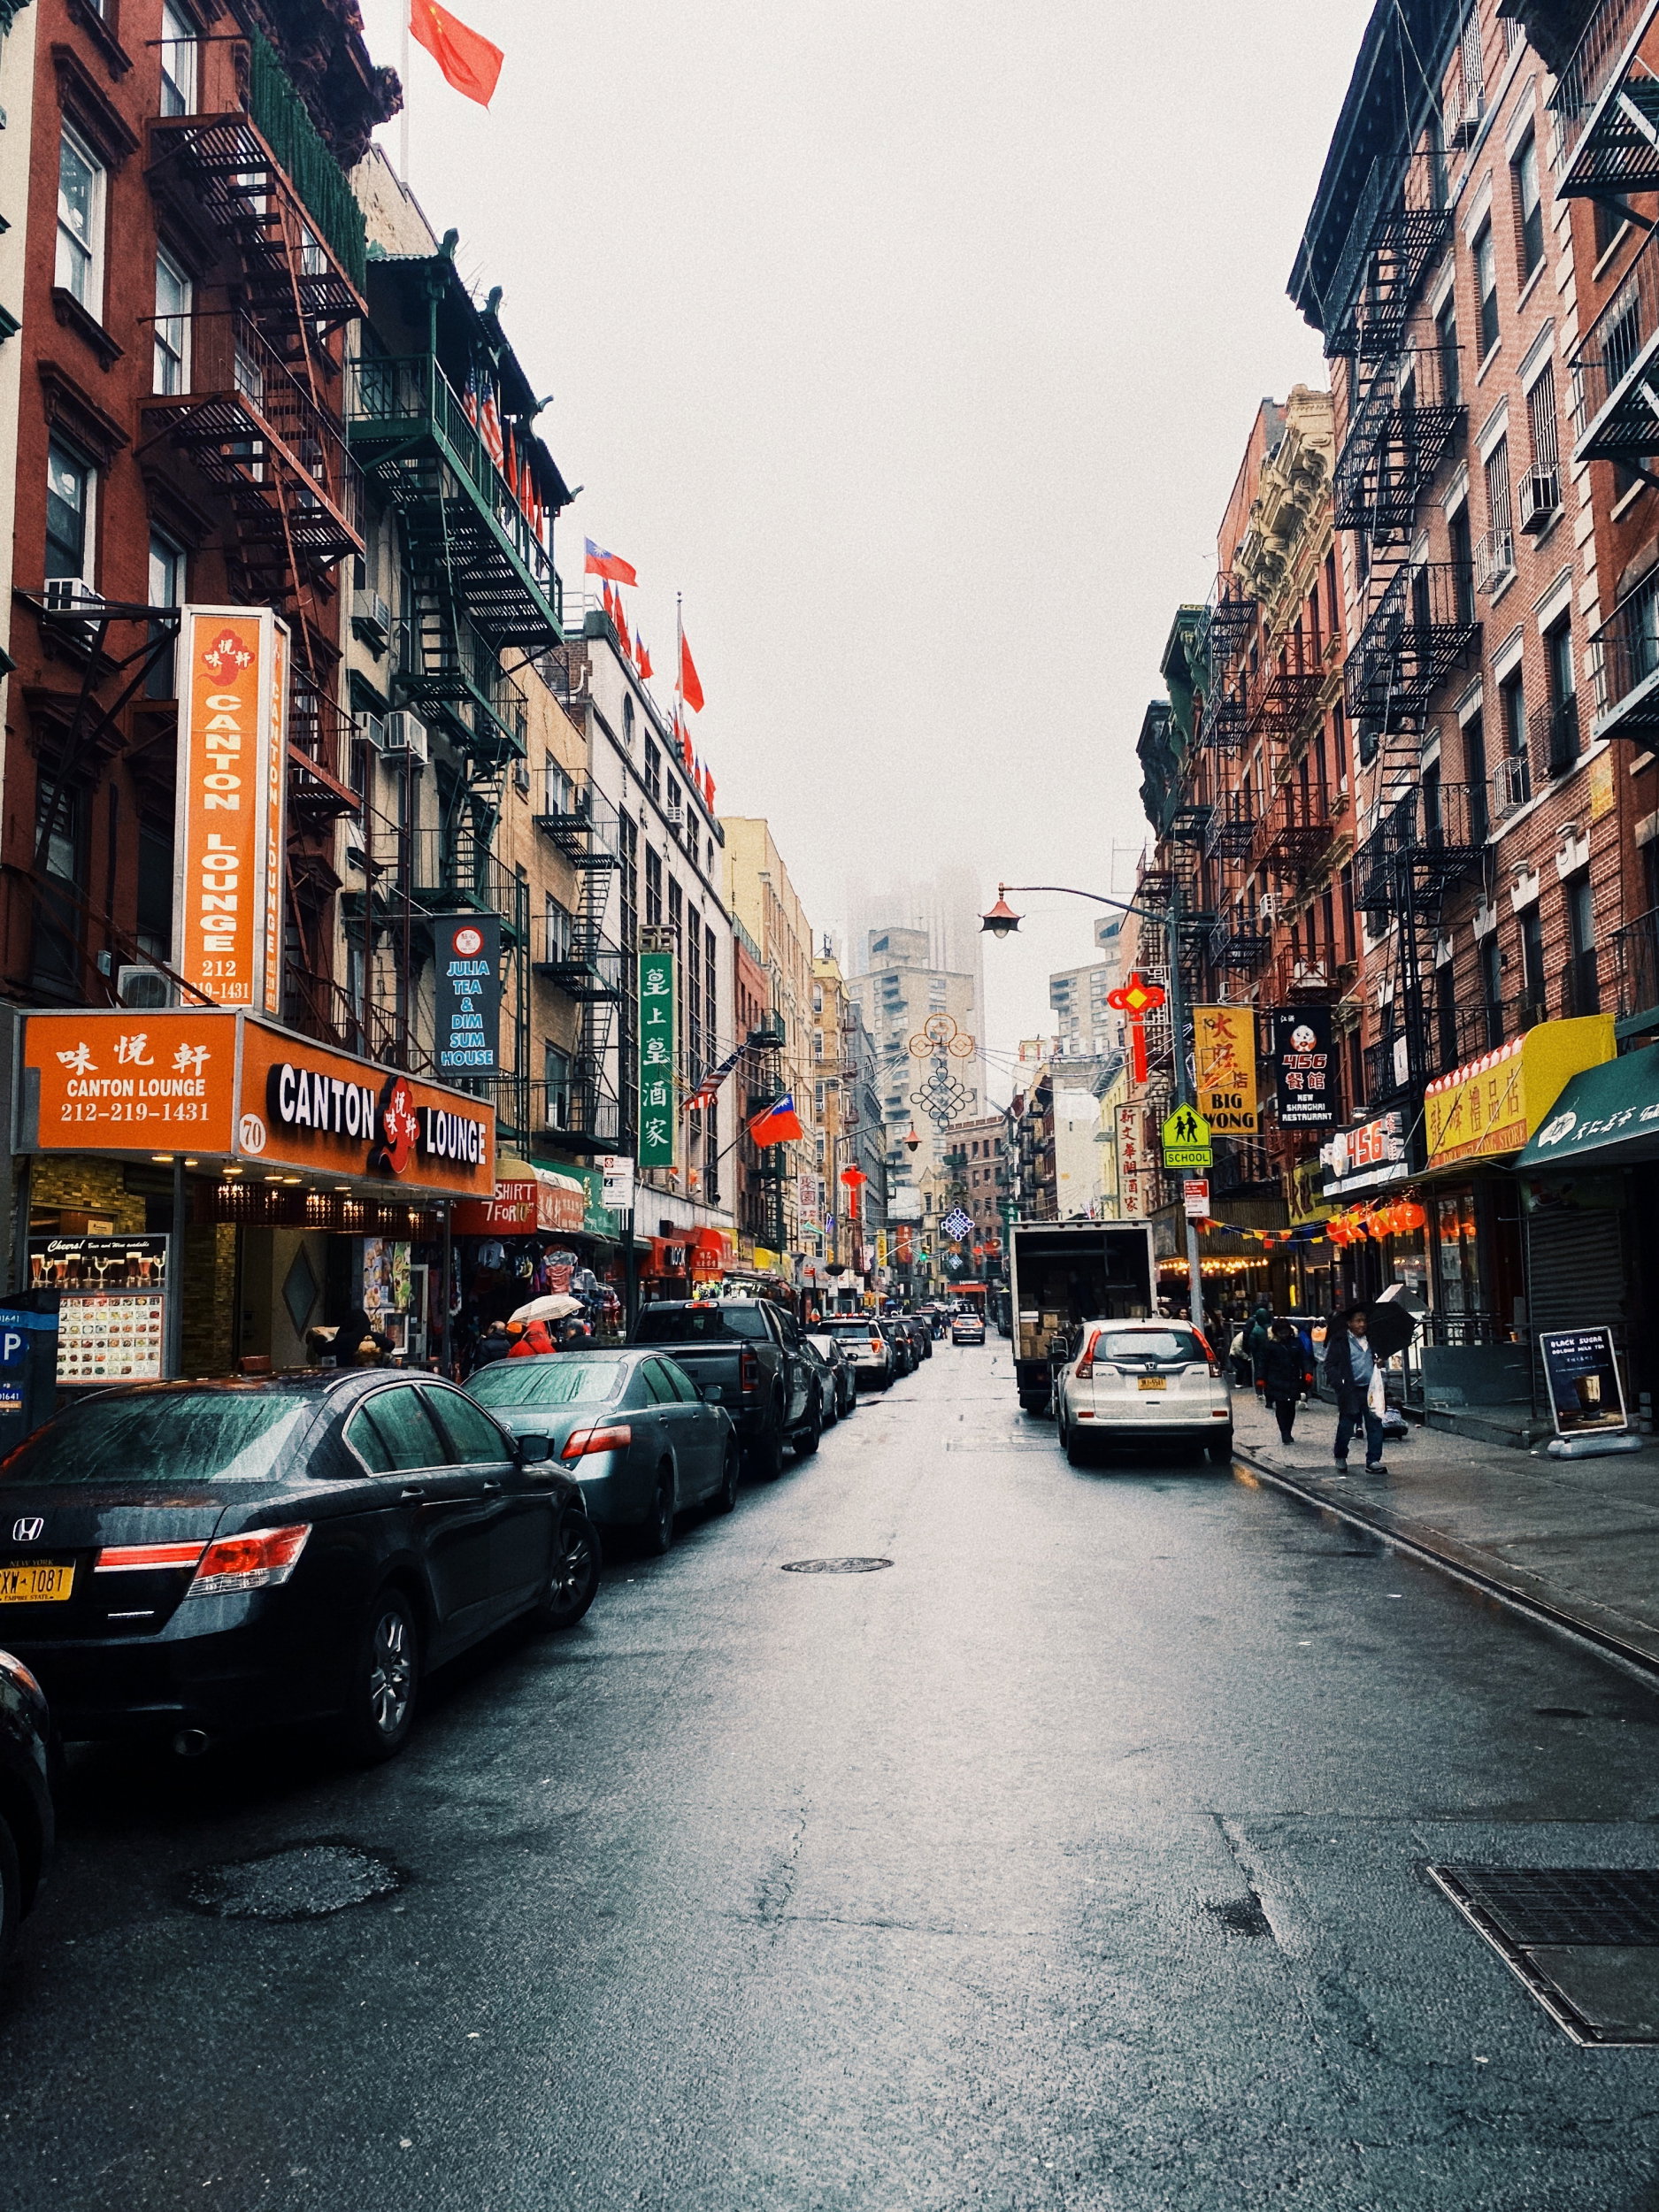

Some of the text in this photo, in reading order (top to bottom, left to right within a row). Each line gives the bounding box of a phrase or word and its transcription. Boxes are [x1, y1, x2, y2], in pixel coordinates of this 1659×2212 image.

[199, 694, 242, 952] CANTON LOUNGE
[266, 828, 277, 954] LOUNGE
[202, 960, 236, 977] 212
[447, 960, 490, 977] JULIA
[453, 979, 482, 995] TEA
[460, 997, 474, 1012] &
[451, 1014, 483, 1030] DIM
[449, 1032, 486, 1048] SUM
[441, 1049, 494, 1067] HOUSE
[1282, 1054, 1328, 1070] 456
[67, 1079, 205, 1097] CANTON LOUNGE
[1211, 1093, 1242, 1110] BIG
[1286, 1102, 1325, 1112] SHANGHAI
[60, 1102, 210, 1122] 212-219-1431
[280, 1063, 487, 1165] CANTON LOUNGE
[1202, 1112, 1255, 1129] WONG
[1281, 1112, 1333, 1122] RESTAURANT
[242, 1119, 262, 1146] 70
[1499, 1123, 1525, 1150] STORE
[1346, 1118, 1383, 1170] 456
[1167, 1153, 1209, 1163] SCHOOL
[495, 1183, 536, 1201] SHIRT
[481, 1201, 494, 1222] 7
[495, 1204, 517, 1222] FOR
[47, 1240, 86, 1253] Cheers!
[4, 1333, 21, 1361] P
[1550, 1335, 1603, 1348] BLACK SUGAR
[0, 1569, 64, 1594] XW 1081
